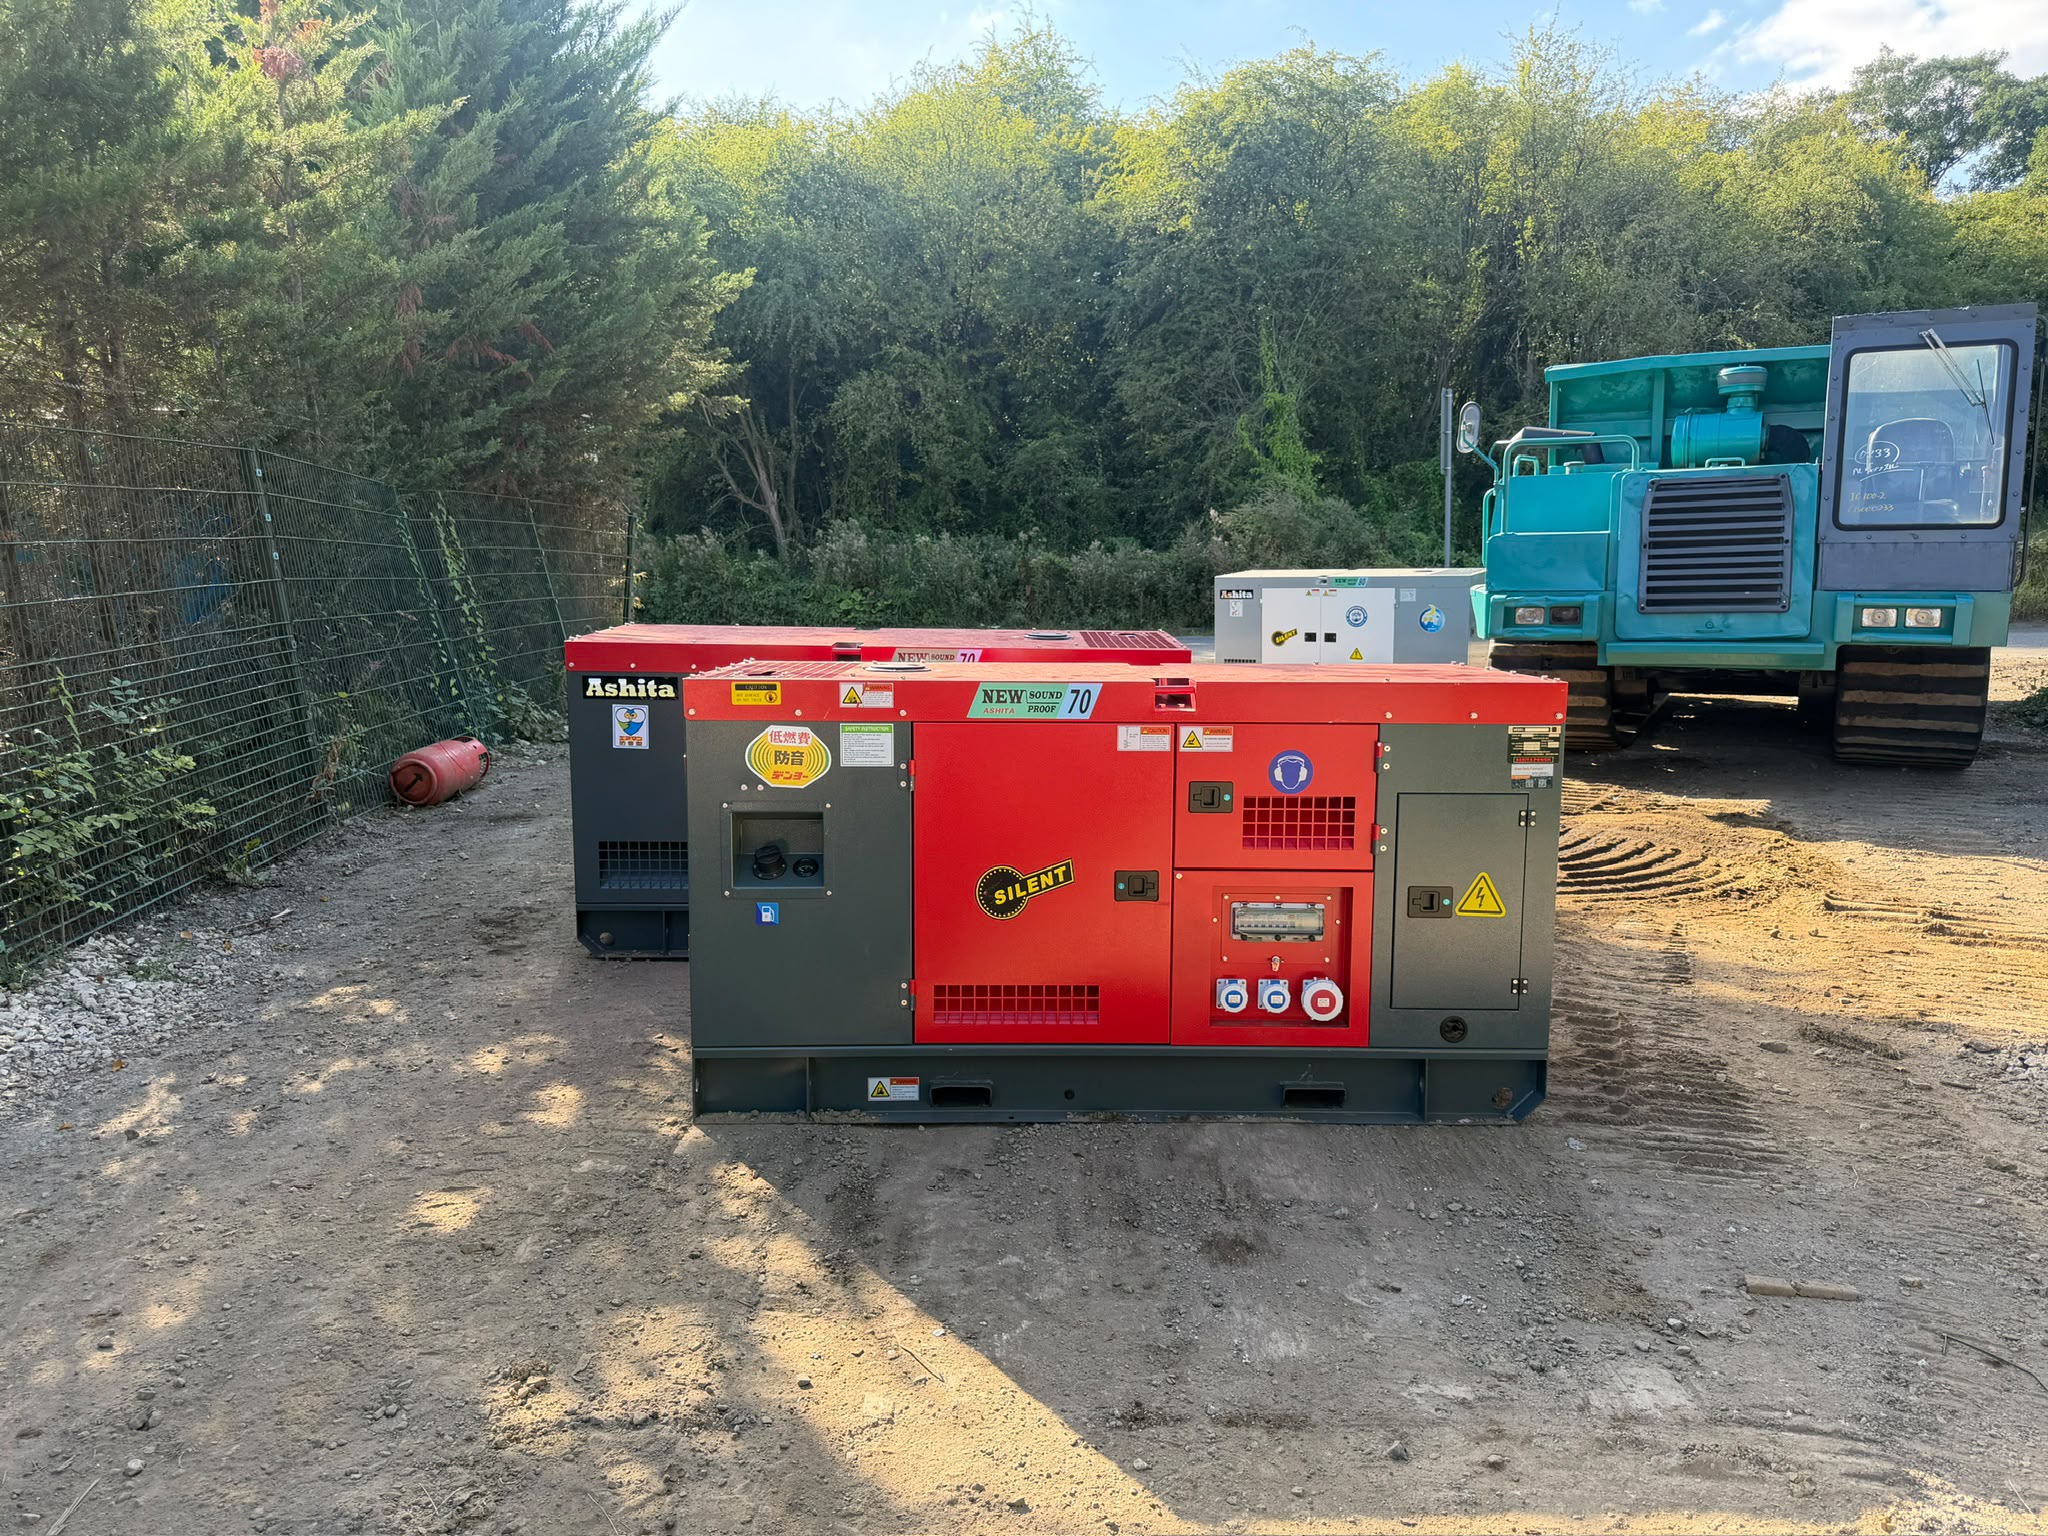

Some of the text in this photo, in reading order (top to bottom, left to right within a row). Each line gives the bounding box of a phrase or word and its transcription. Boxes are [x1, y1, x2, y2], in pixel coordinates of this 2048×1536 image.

[1221, 590, 1253, 599] Ashita
[1275, 630, 1297, 644] SILENT
[897, 652, 955, 663] NEW SOUND
[586, 677, 676, 698] Ashita
[981, 689, 1063, 704] NEW SOUND
[1067, 689, 1092, 714] 70
[983, 707, 1015, 715] ASHITA
[1027, 705, 1057, 713] PROOF
[768, 730, 811, 745] 低燃費
[774, 750, 805, 766] 防音
[771, 770, 809, 780] デンヨー
[994, 865, 1067, 905] SILENT
